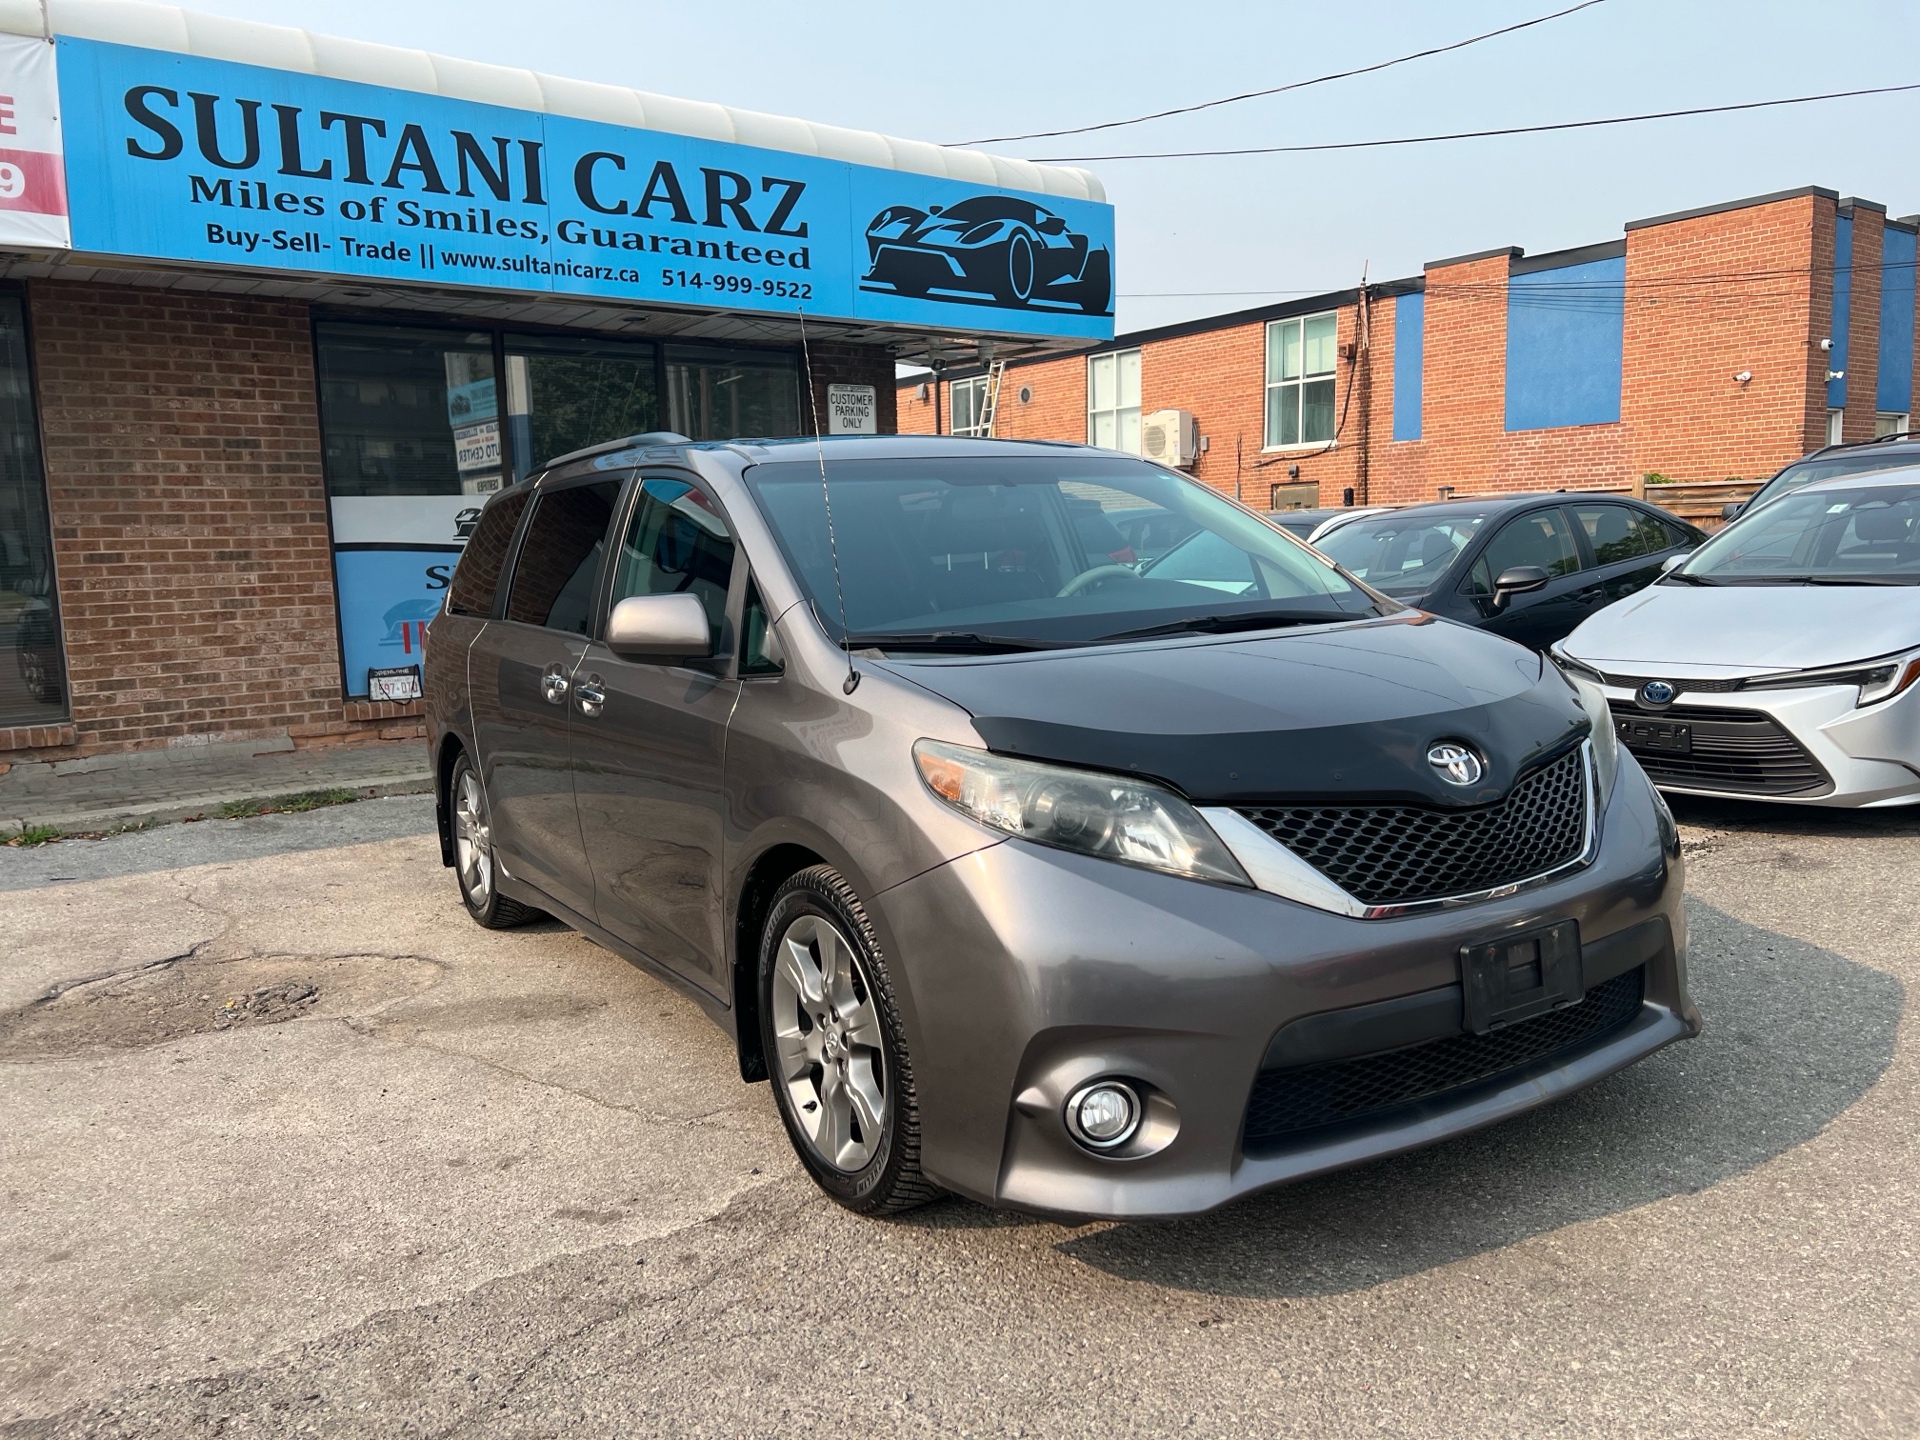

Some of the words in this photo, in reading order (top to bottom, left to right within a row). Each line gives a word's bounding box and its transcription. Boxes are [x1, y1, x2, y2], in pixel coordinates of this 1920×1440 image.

[124, 85, 548, 206] SULTANI
[573, 151, 809, 239] CARZ
[188, 175, 326, 217] Miles
[339, 196, 388, 223] of
[397, 200, 549, 246] Smiles,
[557, 219, 812, 270] Guaranteed
[339, 236, 412, 262] Trade
[441, 250, 640, 284] www.sultanicarz.ca
[661, 269, 813, 300] 514-999-9522
[830, 393, 874, 406] CUSTOMER
[835, 405, 870, 418] PARKING
[842, 416, 863, 429] ONLY
